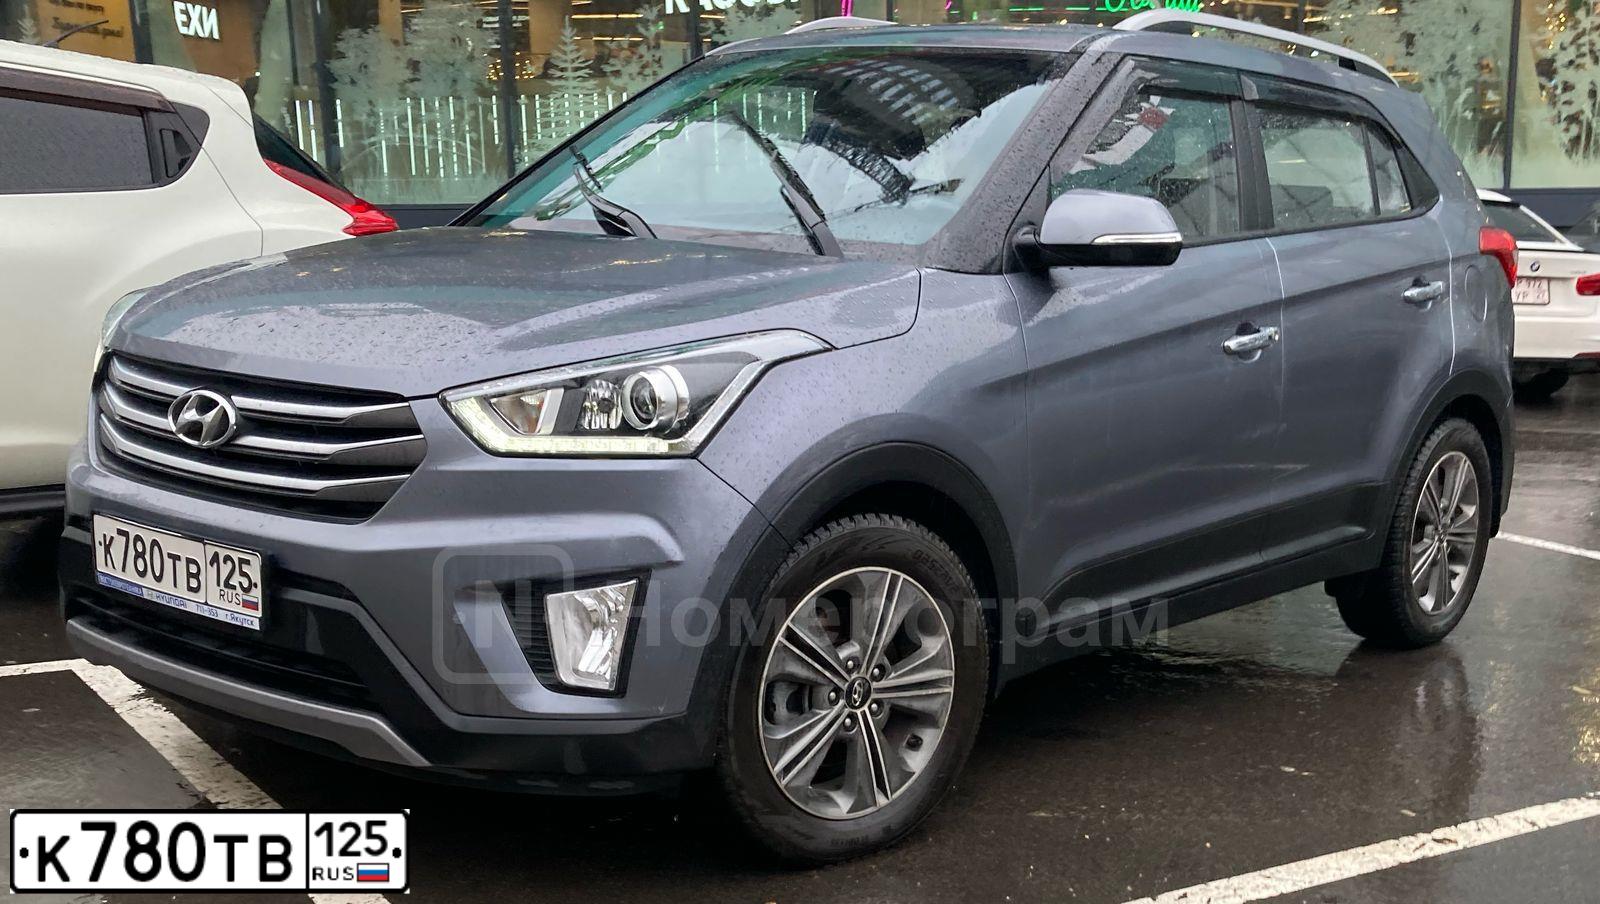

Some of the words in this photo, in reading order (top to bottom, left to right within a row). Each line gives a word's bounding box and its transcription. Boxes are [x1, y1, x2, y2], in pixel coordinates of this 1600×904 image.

[103, 528, 202, 594] К780ТВ
[209, 550, 253, 593] 125
[219, 588, 241, 606] RUS
